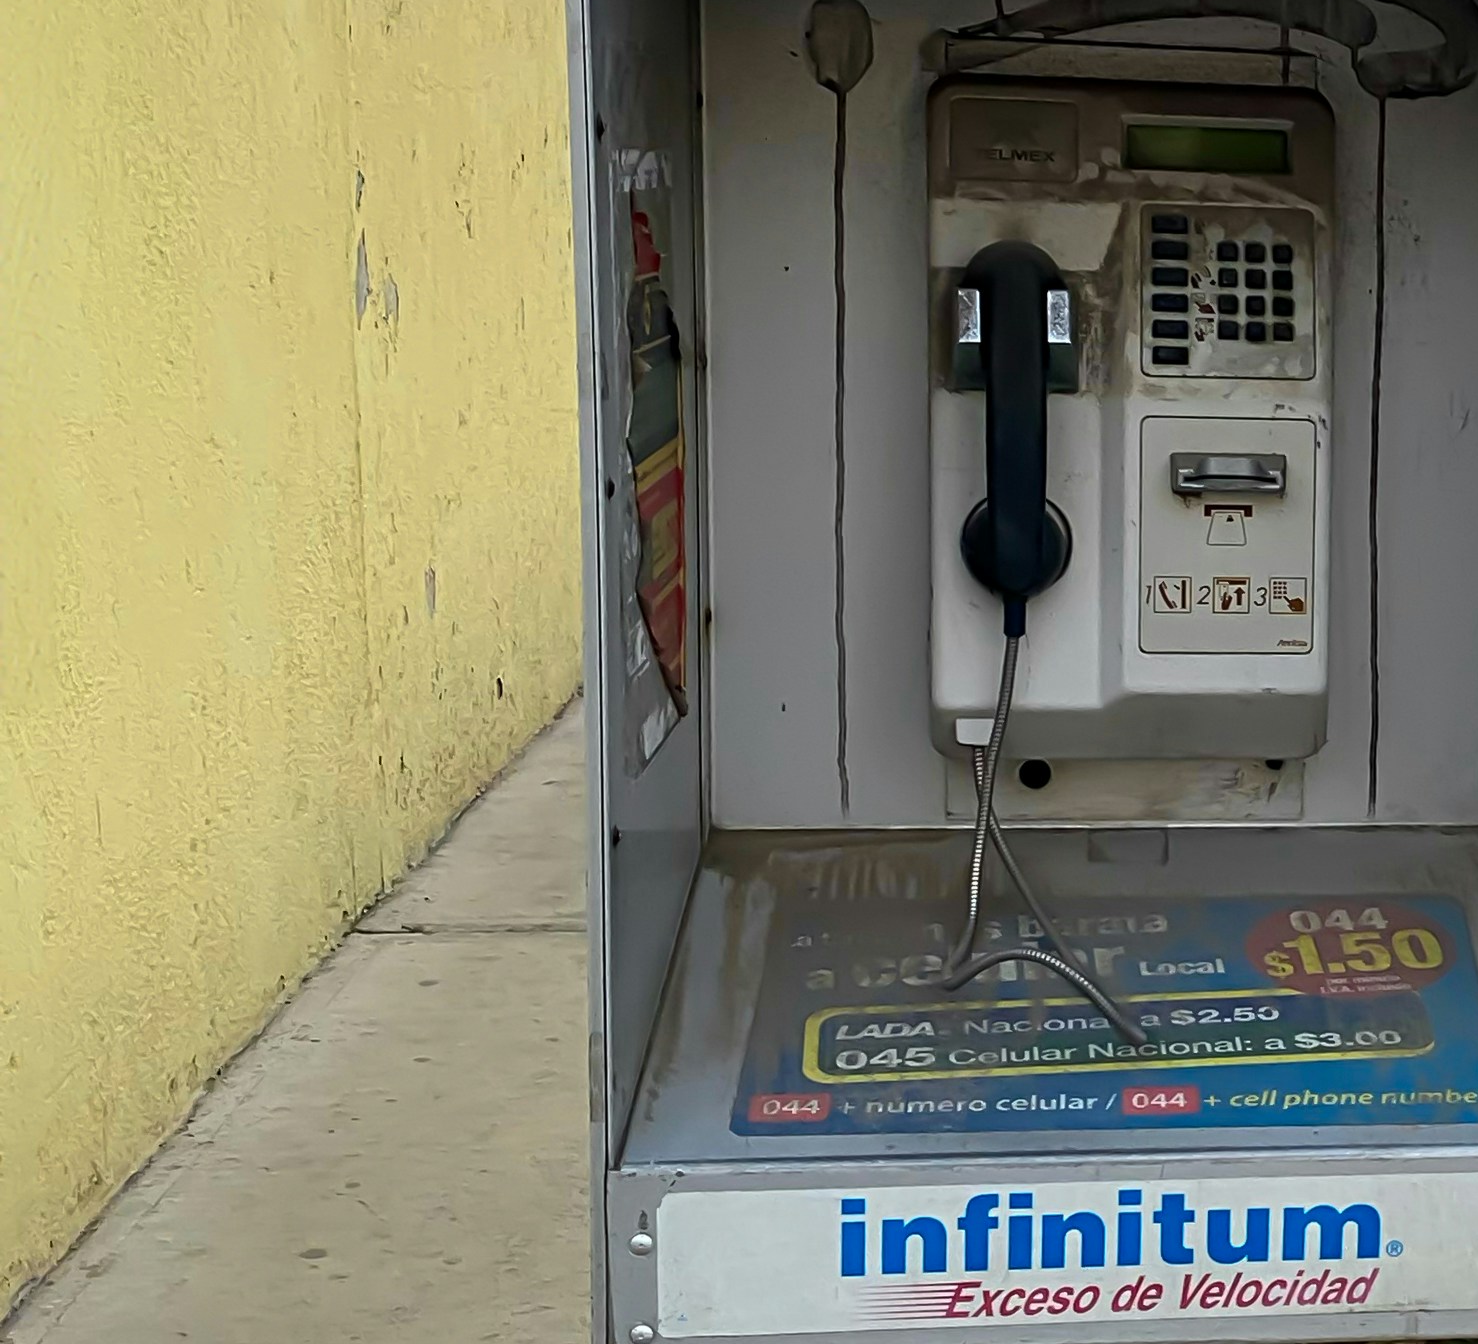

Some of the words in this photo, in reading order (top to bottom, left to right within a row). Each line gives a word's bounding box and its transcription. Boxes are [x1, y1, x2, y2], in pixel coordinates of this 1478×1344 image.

[1197, 585, 1211, 605] 2
[1253, 587, 1268, 606] 3
[1289, 907, 1389, 933] 044
[1264, 928, 1443, 980] $1.50
[1139, 957, 1226, 978] Local
[1140, 1014, 1161, 1027] a
[1170, 1006, 1280, 1027] $2.50
[836, 1047, 936, 1070] 045
[949, 1046, 1078, 1066] Celular
[1088, 1035, 1252, 1059] Nacional:
[1264, 1036, 1286, 1050] a
[1294, 1030, 1401, 1050] $3.00
[763, 1099, 820, 1115] 044
[996, 1093, 1098, 1112] celular
[1132, 1092, 1188, 1109] 044
[1229, 1089, 1277, 1107] cell
[1282, 1088, 1374, 1110] phone
[841, 1189, 1382, 1278] infinitum
[946, 1280, 1101, 1319] Exceso
[1111, 1275, 1163, 1311] de
[1180, 1267, 1381, 1310] Velocidad
